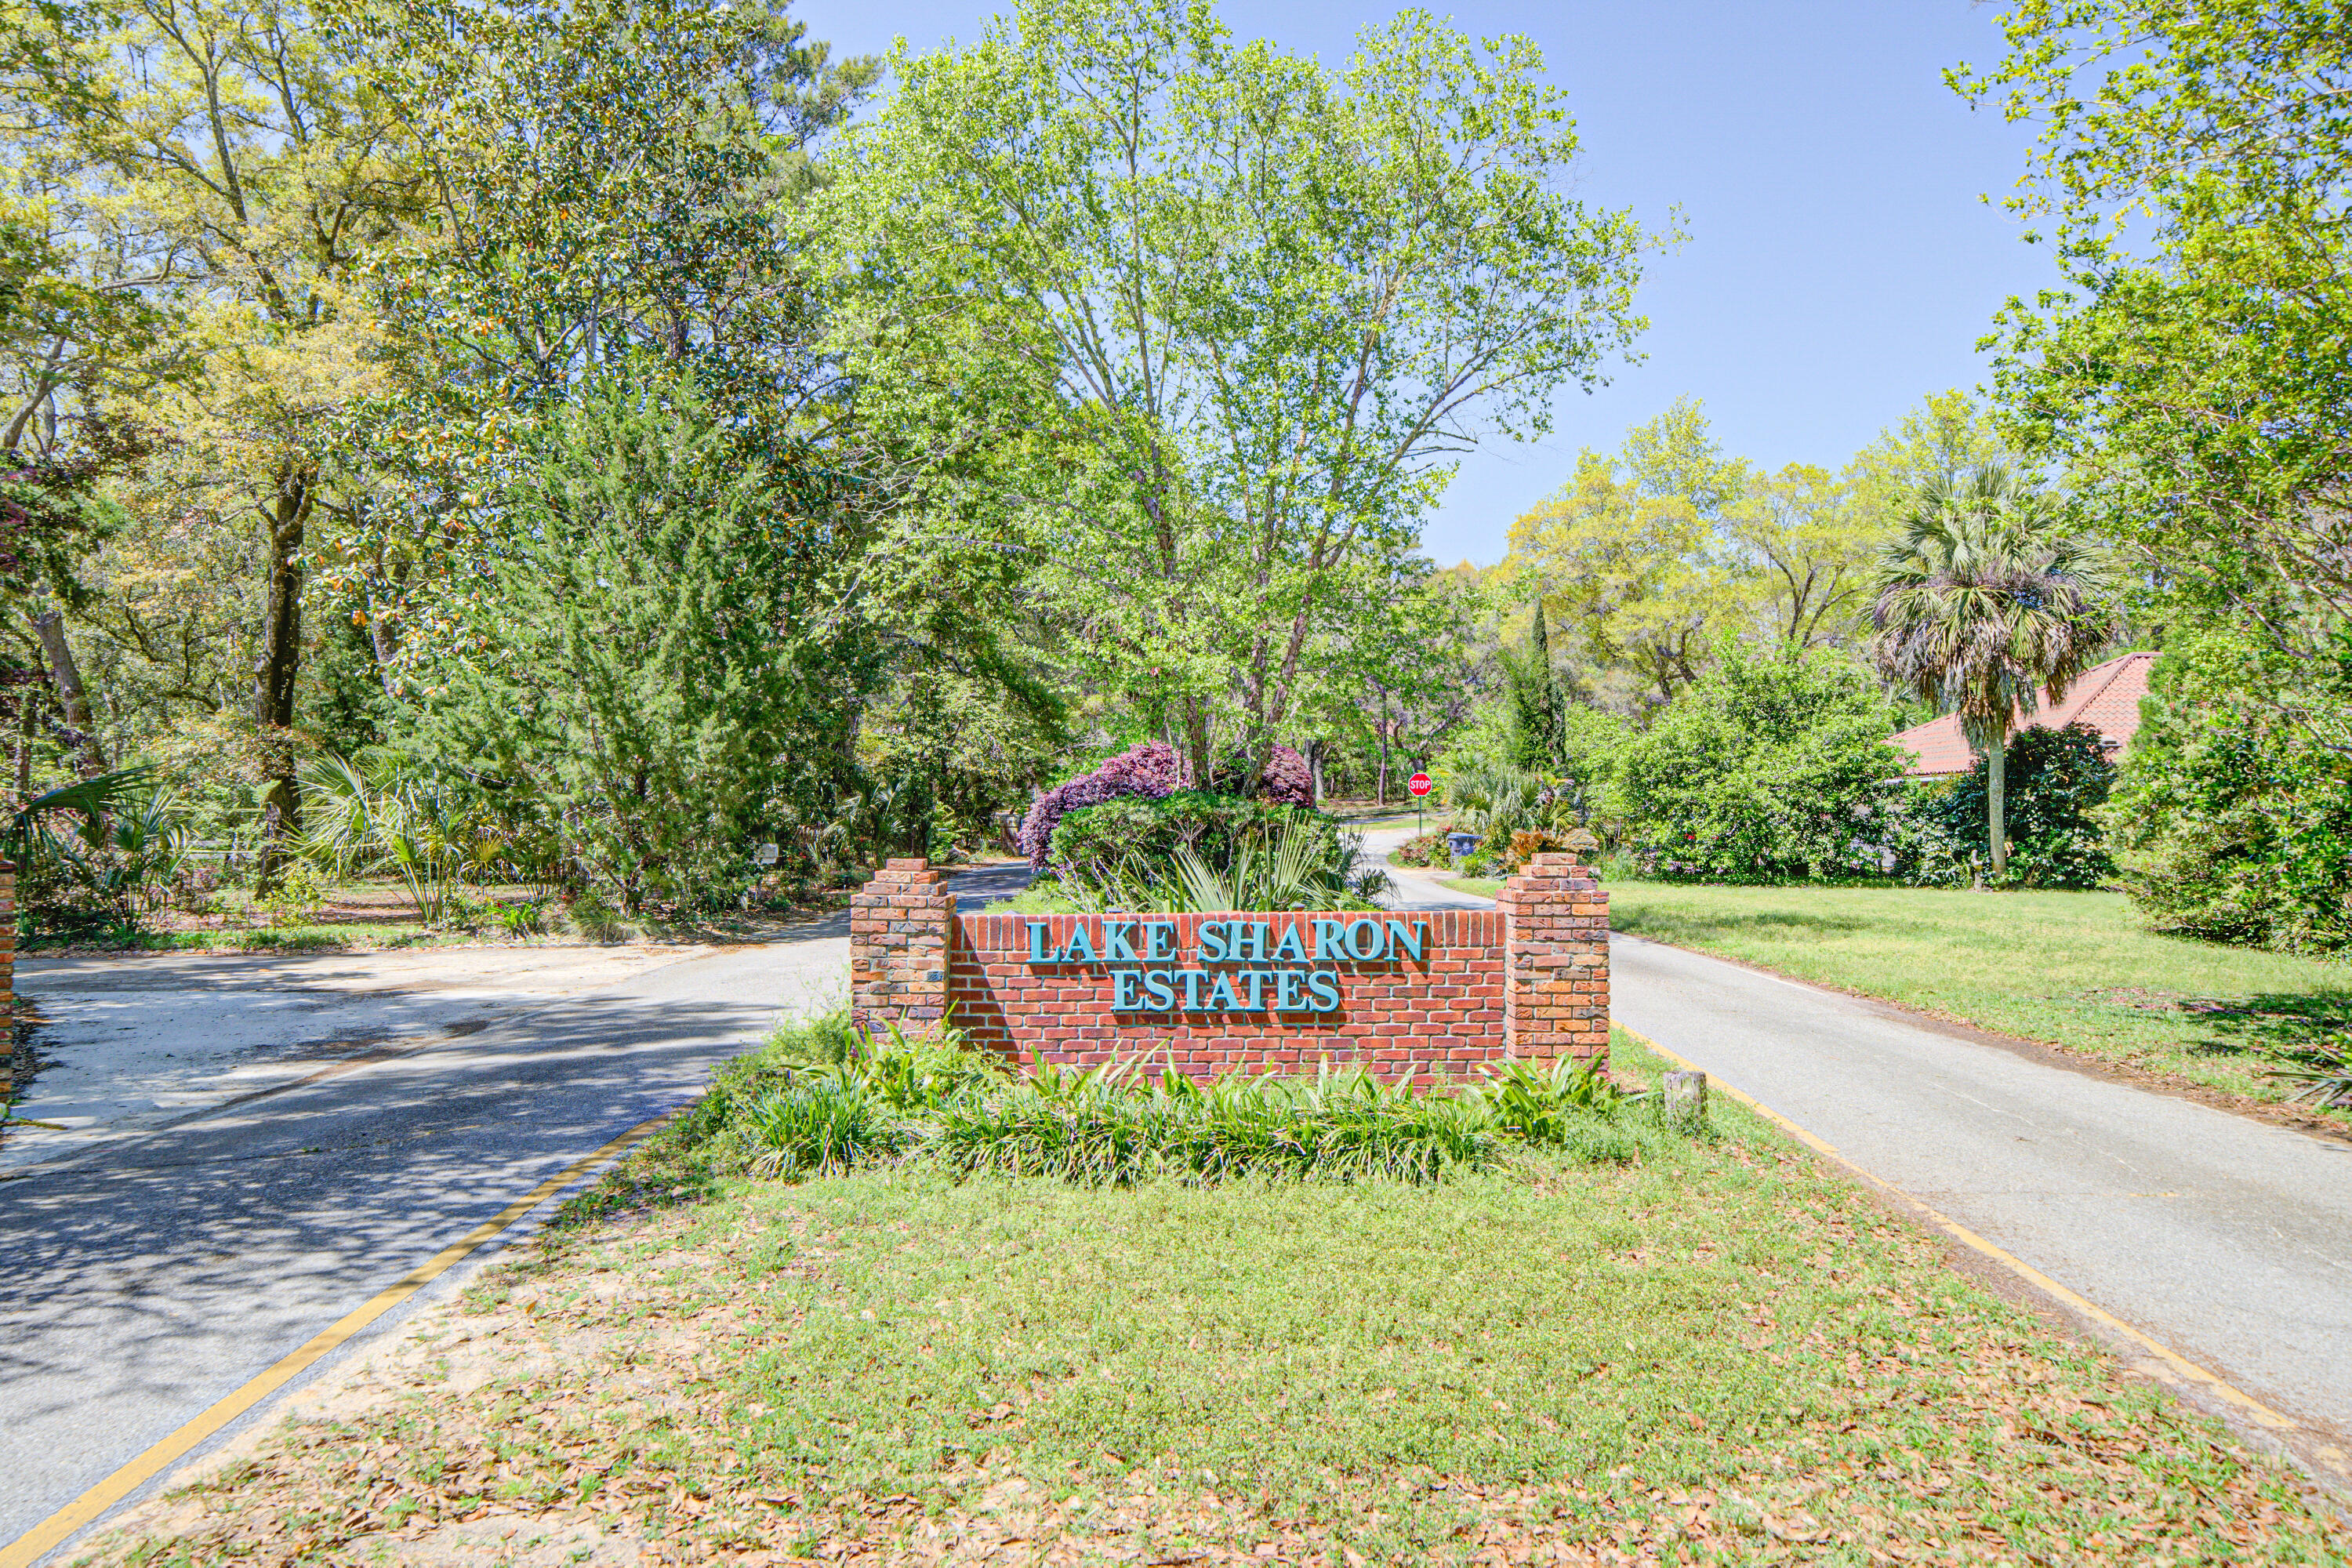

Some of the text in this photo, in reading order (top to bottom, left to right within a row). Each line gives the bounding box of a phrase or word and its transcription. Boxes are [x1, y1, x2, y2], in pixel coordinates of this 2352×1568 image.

[1410, 780, 1430, 789] STOP
[1025, 919, 1427, 963] LAKE SHARON
[1109, 969, 1339, 1012] ESTATES
